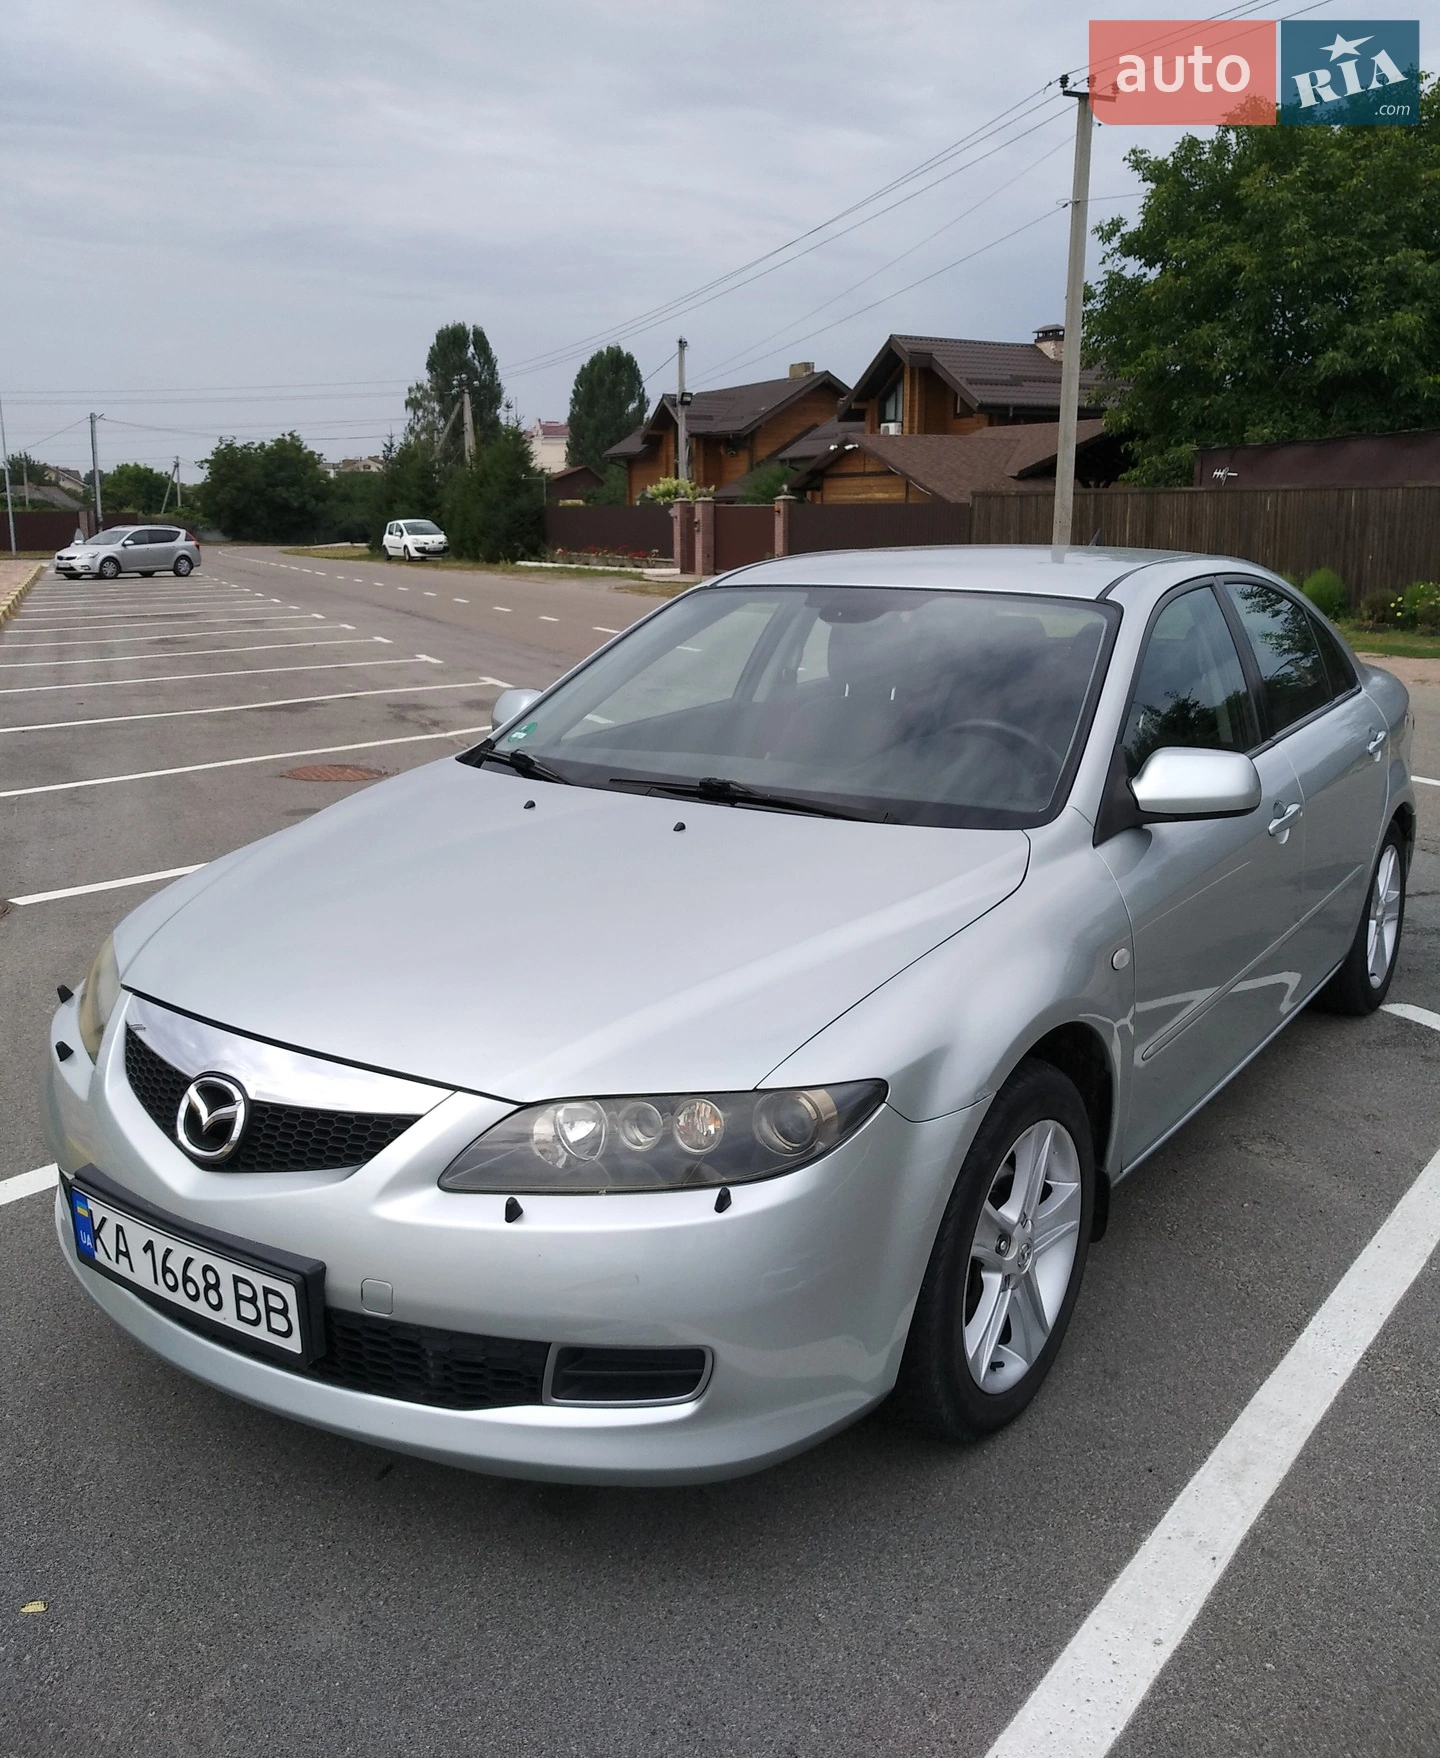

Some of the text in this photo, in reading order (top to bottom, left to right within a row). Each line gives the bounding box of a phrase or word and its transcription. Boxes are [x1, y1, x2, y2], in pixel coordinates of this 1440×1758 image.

[80, 1229, 93, 1249] UA
[89, 1208, 293, 1339] KA 1668 BB
